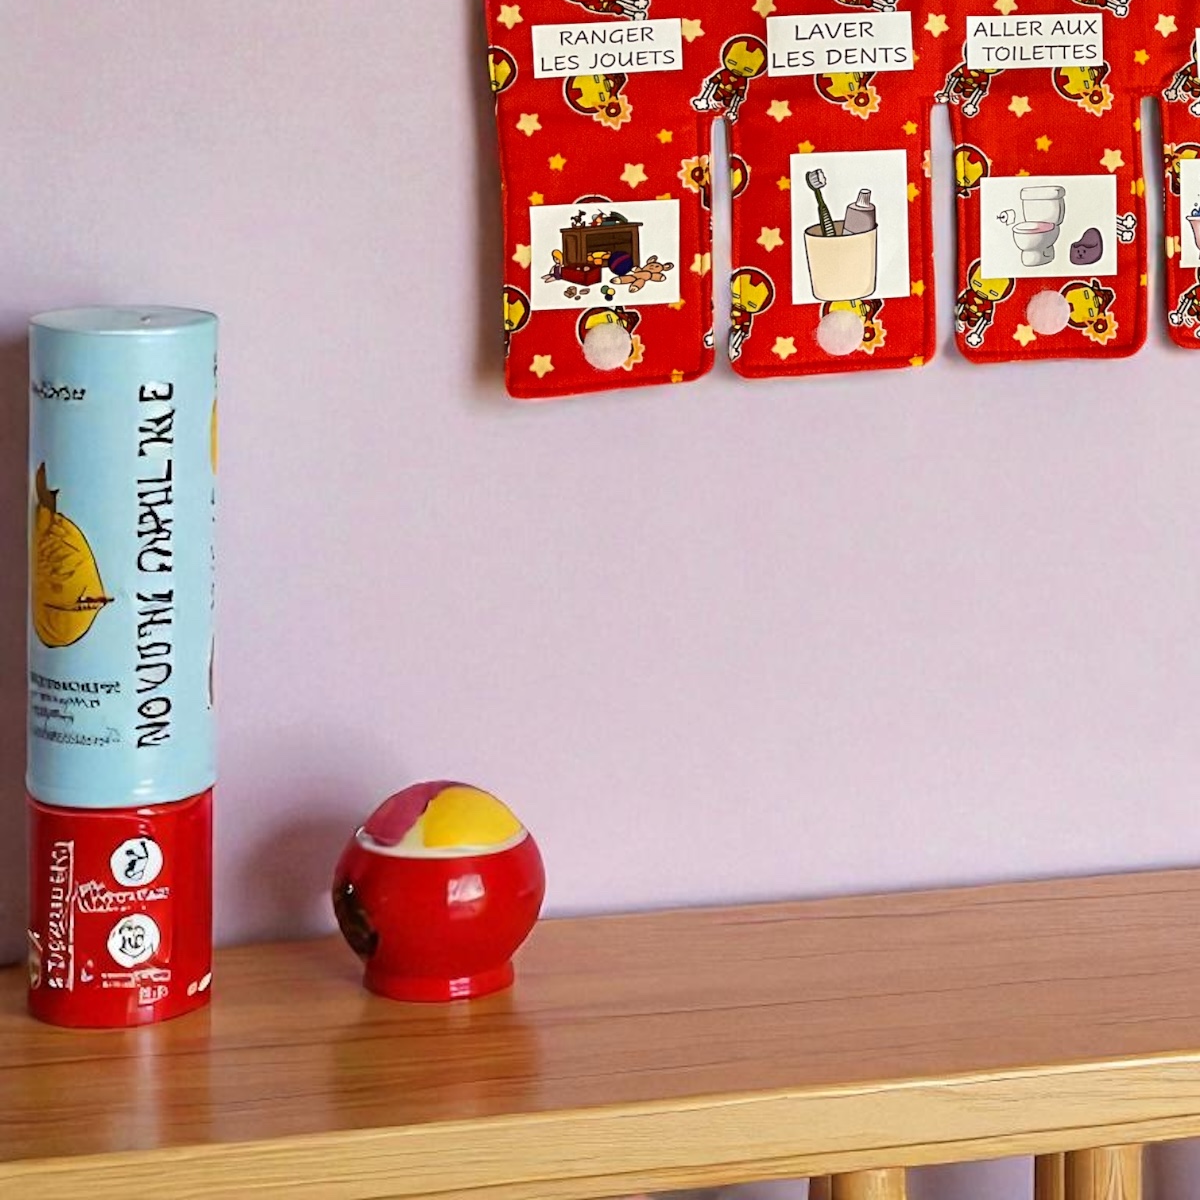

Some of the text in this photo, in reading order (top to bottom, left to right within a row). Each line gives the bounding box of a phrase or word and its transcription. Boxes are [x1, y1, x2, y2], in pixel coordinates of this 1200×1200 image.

[559, 26, 654, 46] RANGER
[795, 21, 874, 41] LAVER
[973, 19, 1098, 37] ALLER AUX
[541, 49, 675, 73] LES JOUETS
[772, 46, 907, 69] LES DENTS
[982, 44, 1097, 62] TOILETTES
